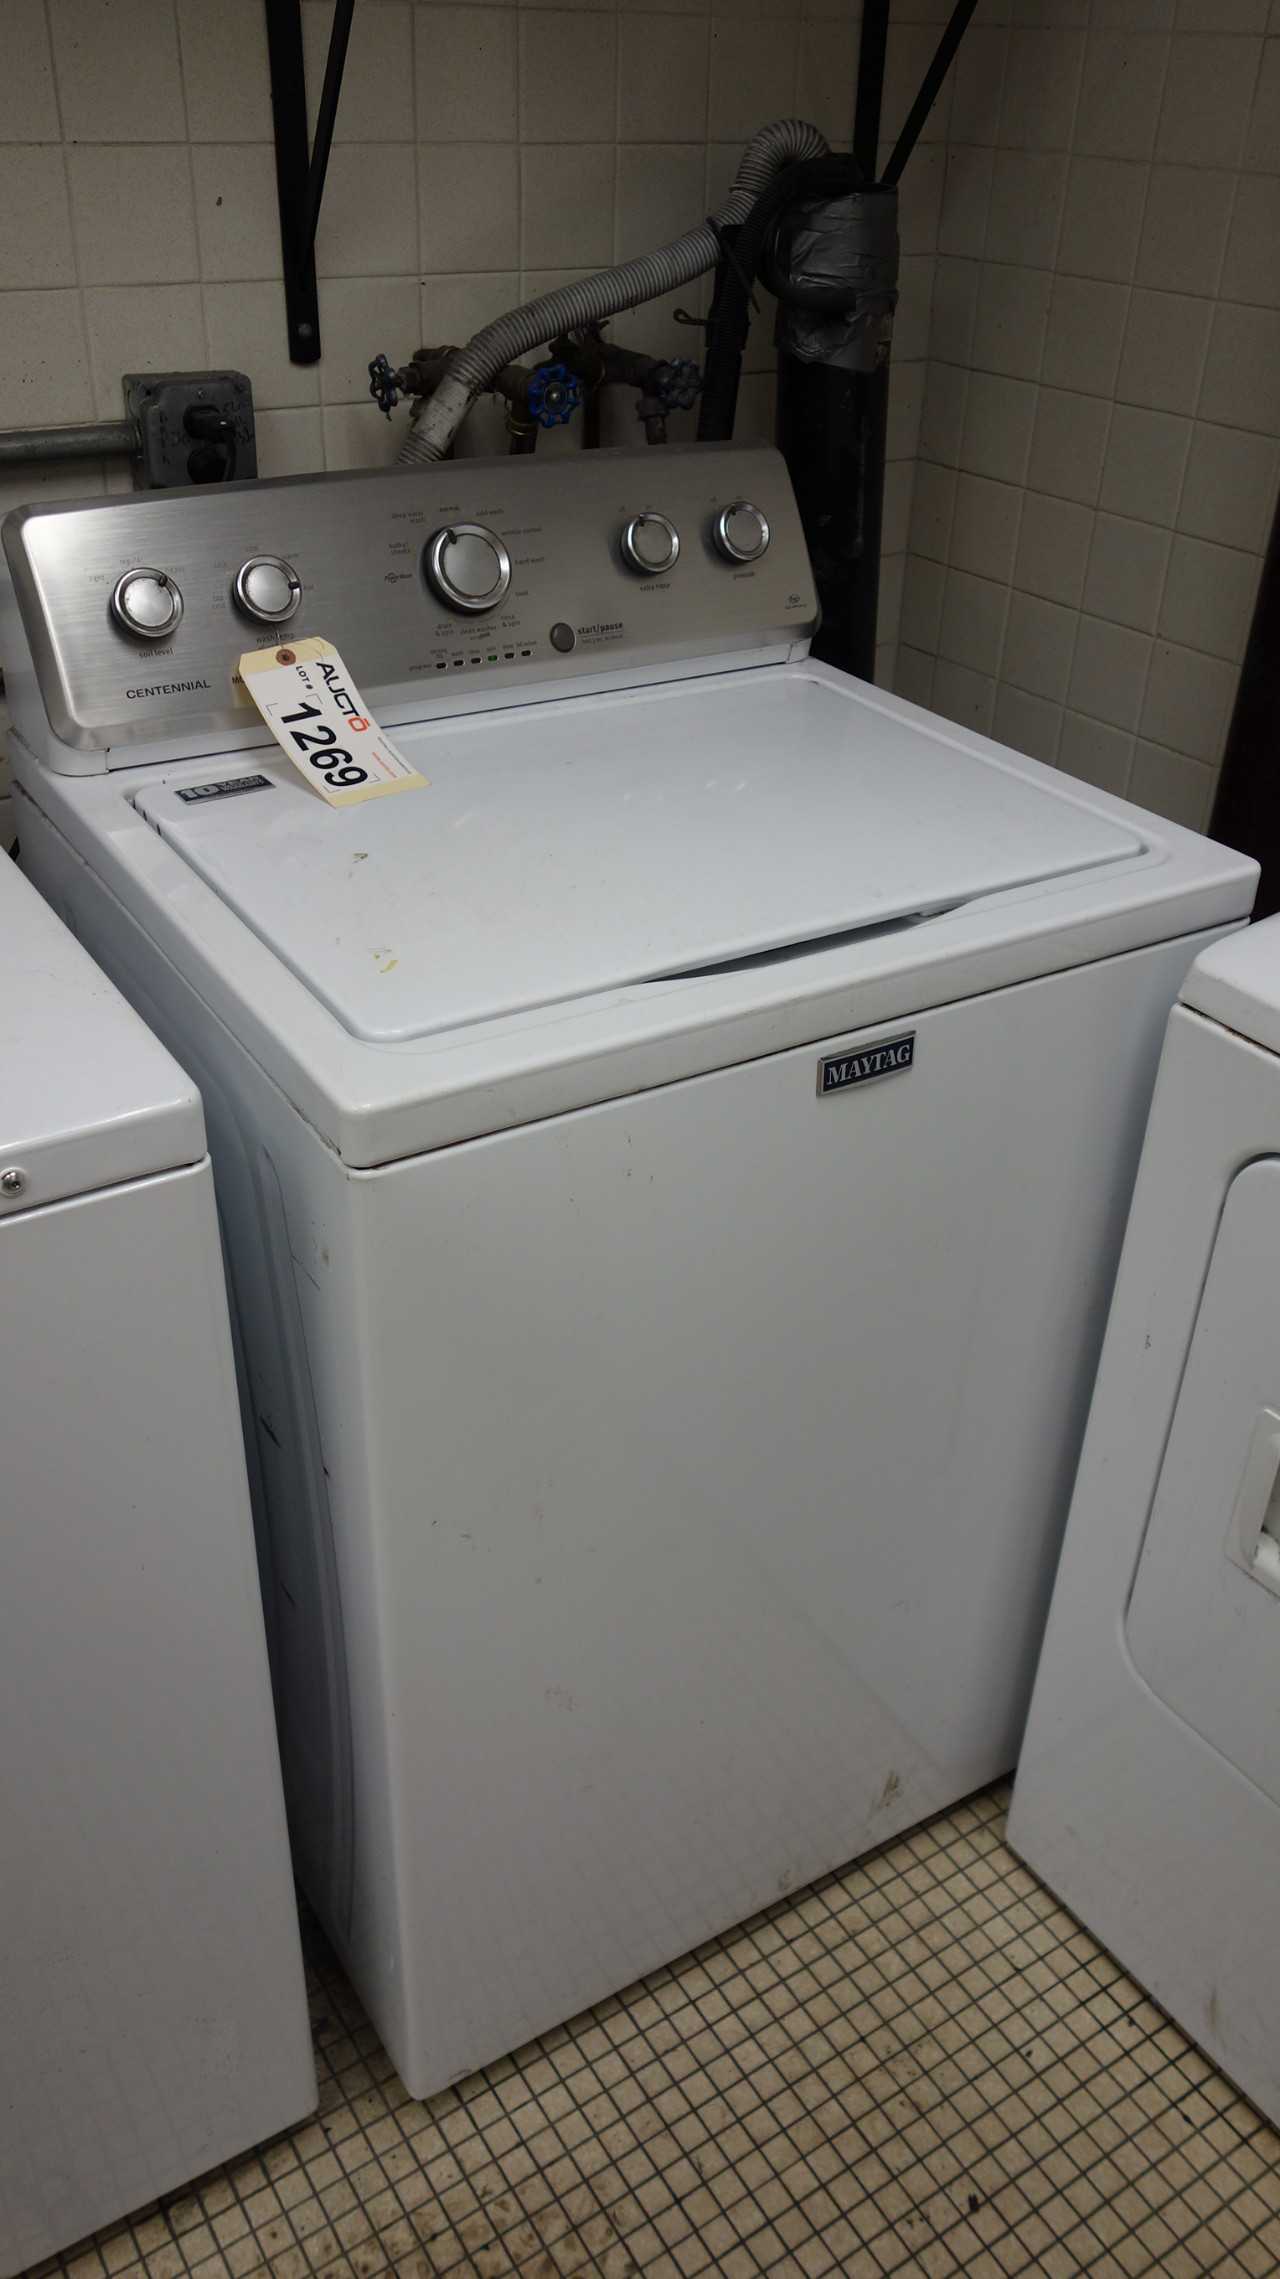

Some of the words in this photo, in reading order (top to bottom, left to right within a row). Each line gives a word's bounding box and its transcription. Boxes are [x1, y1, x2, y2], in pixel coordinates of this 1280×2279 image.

[577, 621, 623, 635] start/pause
[296, 665, 310, 684] LOT
[126, 679, 212, 700] CENTENNIAL
[281, 702, 369, 787] 1269
[180, 785, 220, 799] 10
[826, 1044, 911, 1085] MAYTAG
